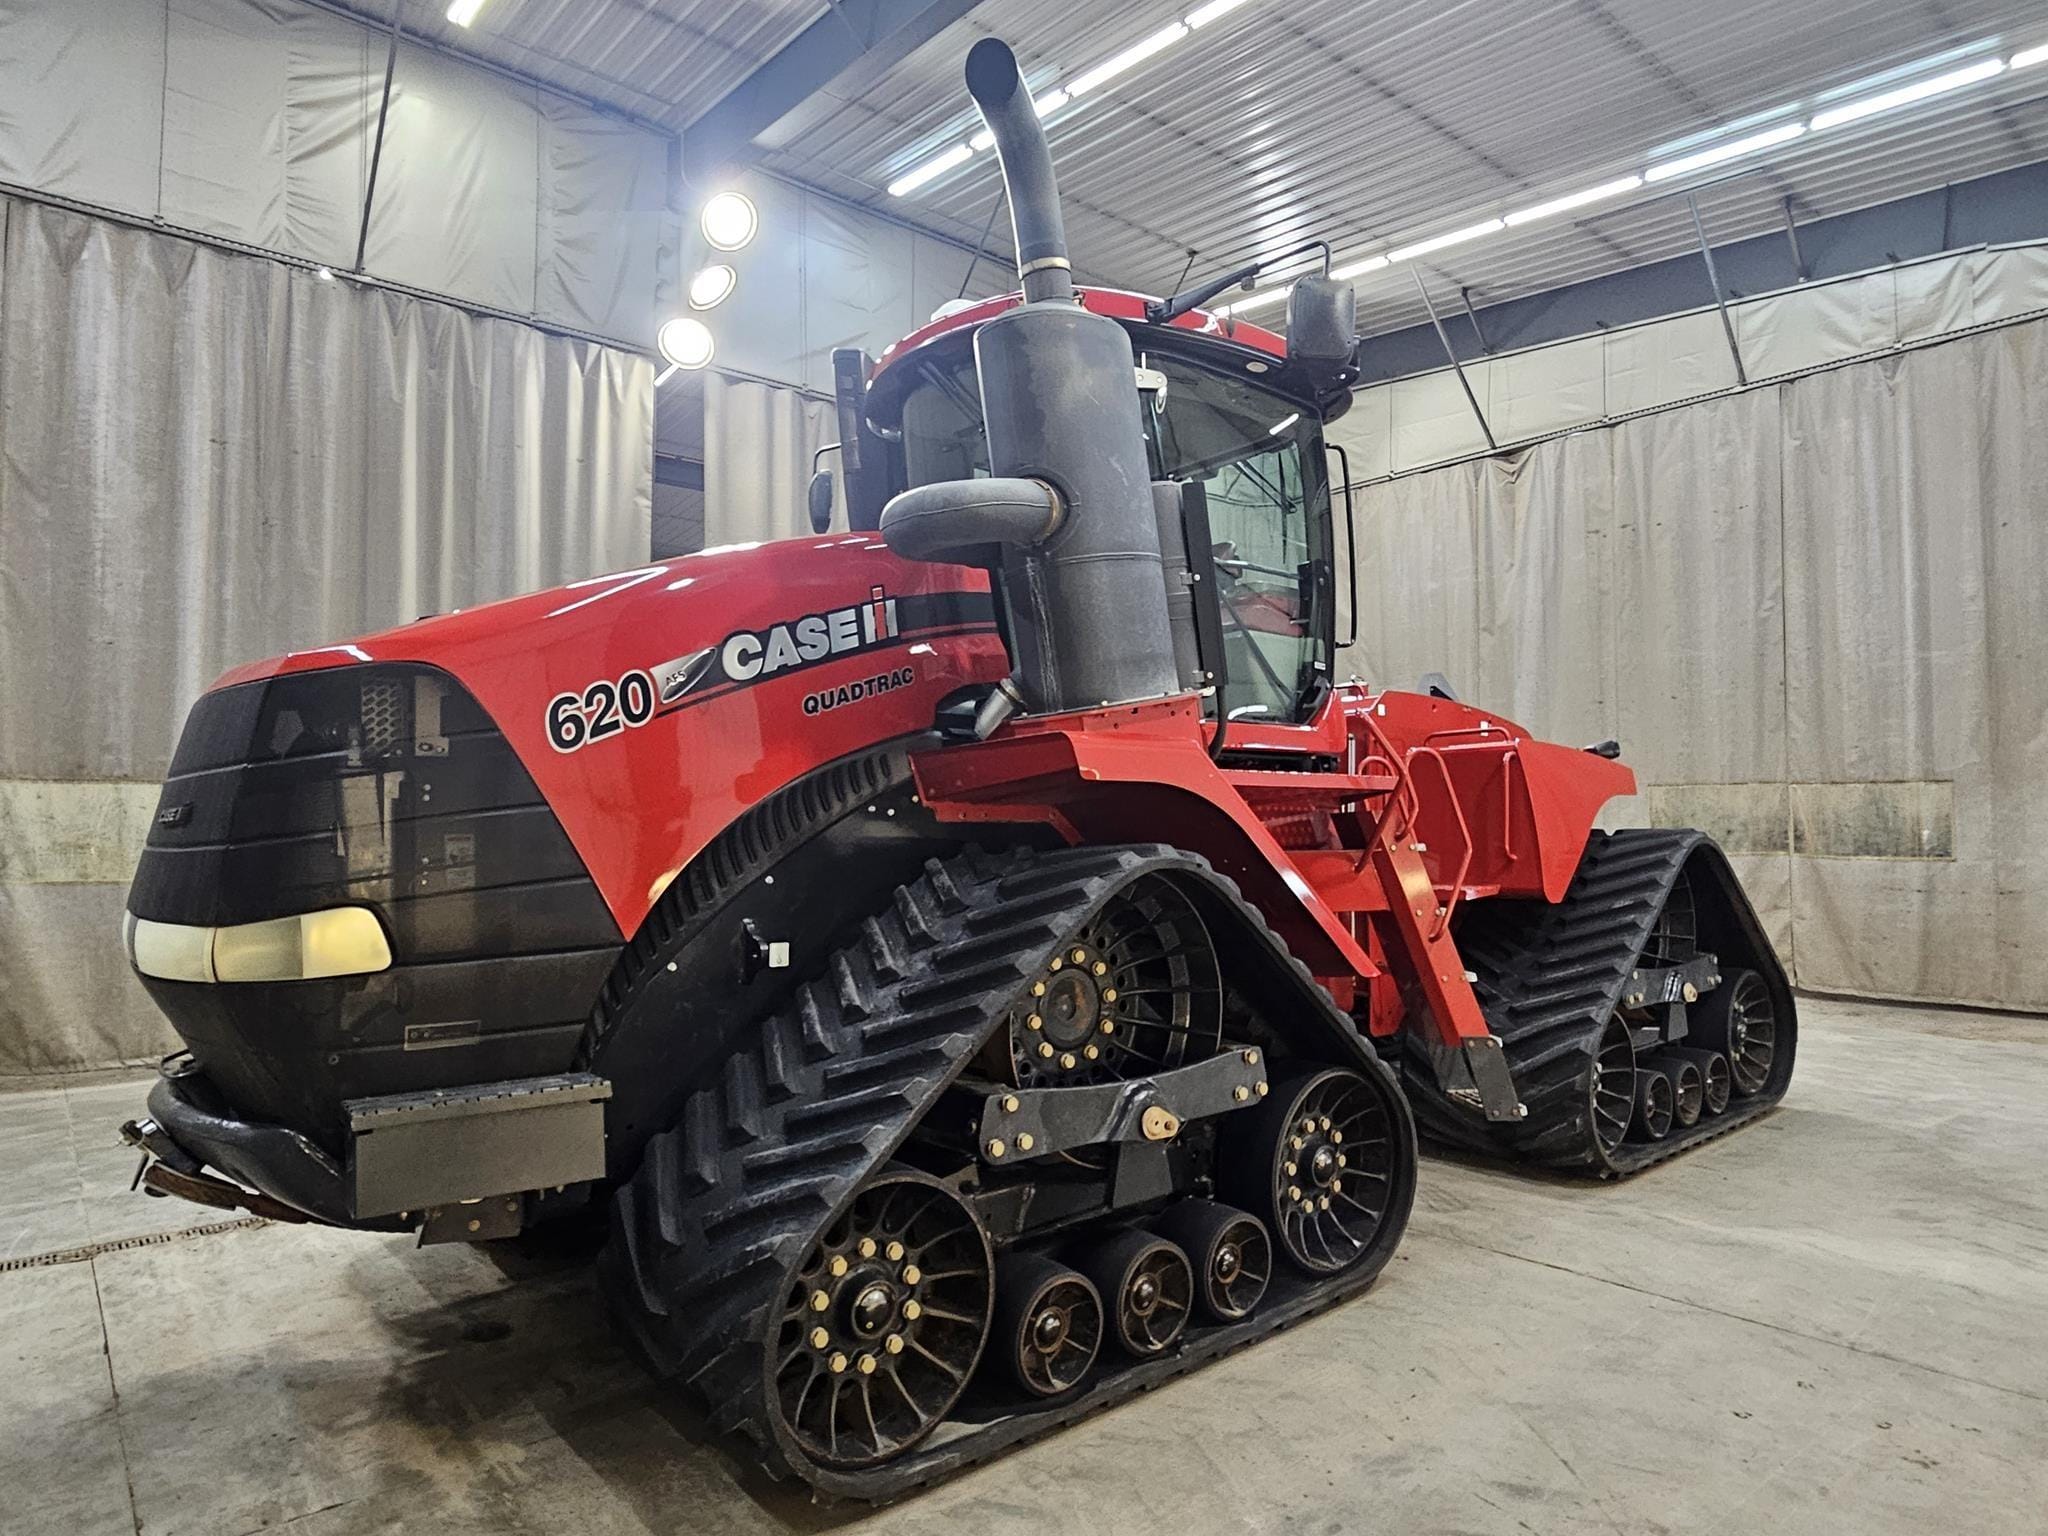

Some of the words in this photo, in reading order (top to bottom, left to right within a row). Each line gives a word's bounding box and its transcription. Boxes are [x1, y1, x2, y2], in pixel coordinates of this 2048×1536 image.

[722, 608, 859, 681] CASE
[665, 670, 687, 686] AFS
[803, 667, 914, 715] QUADTRAC
[546, 670, 655, 753] 620
